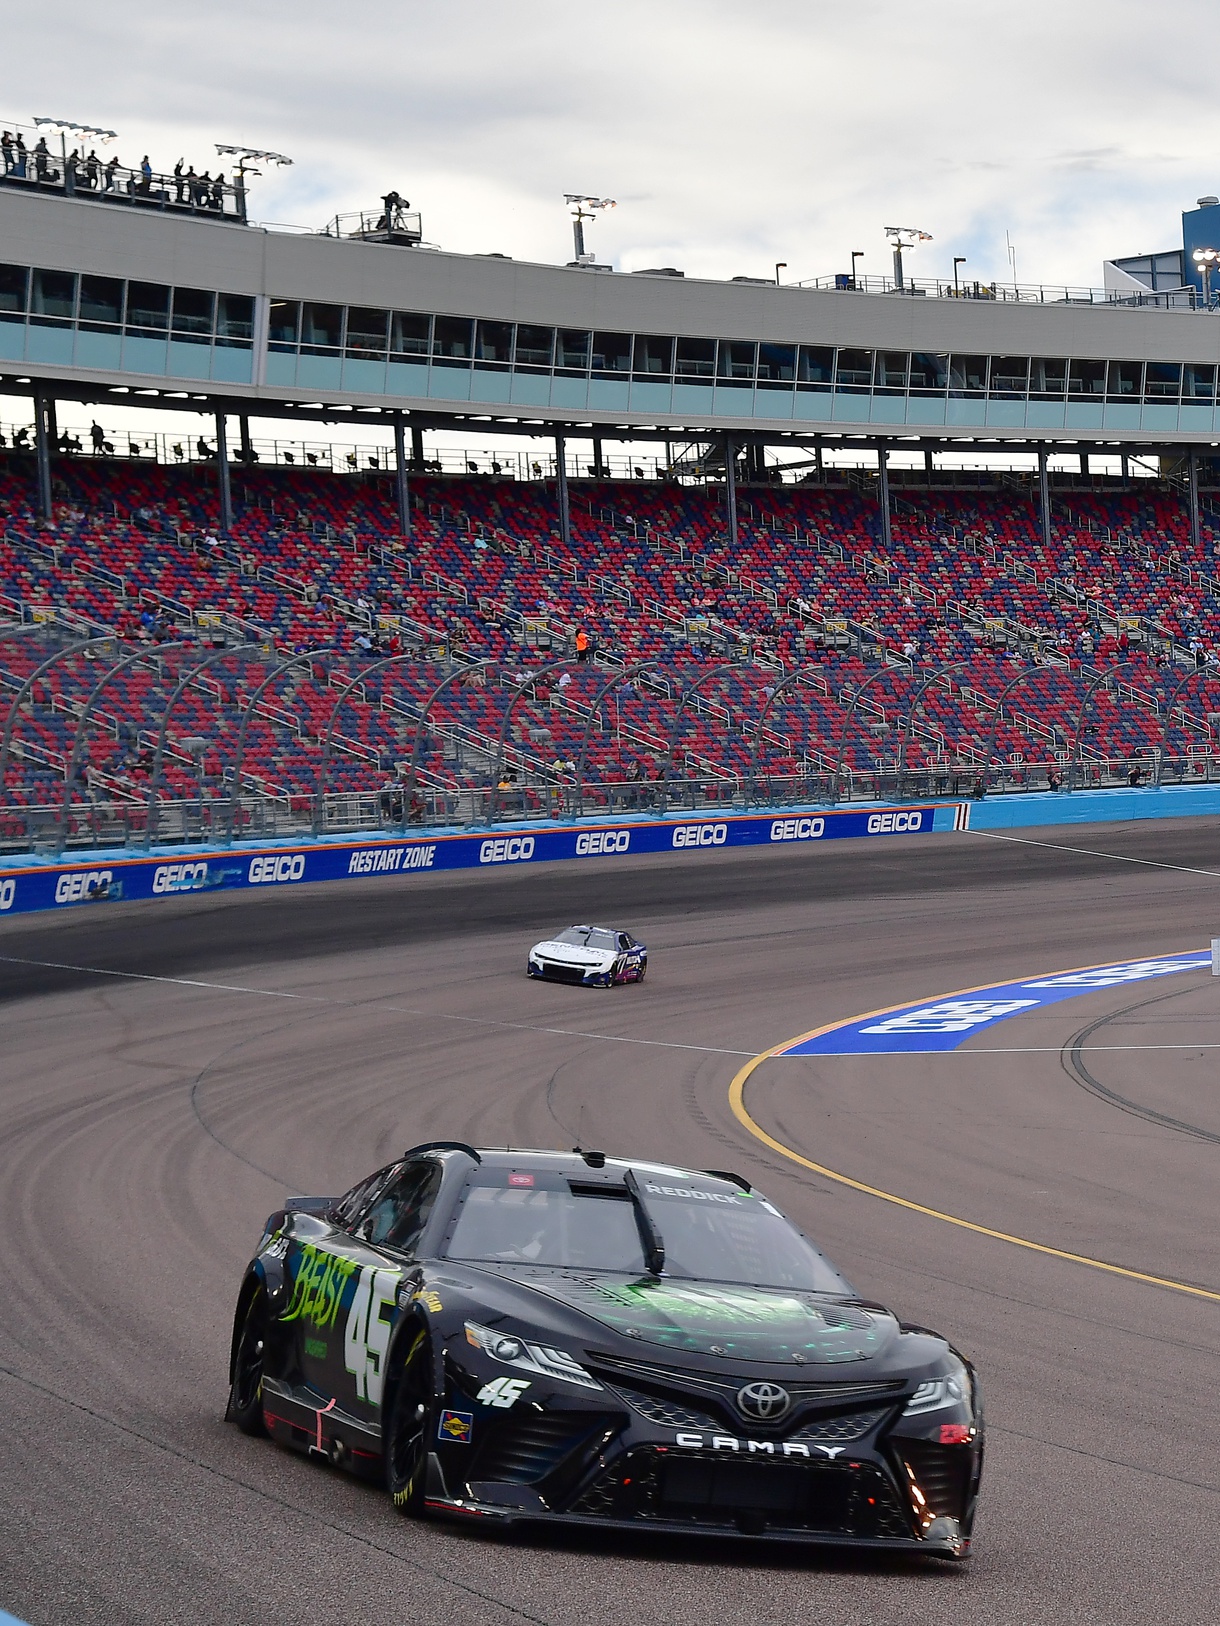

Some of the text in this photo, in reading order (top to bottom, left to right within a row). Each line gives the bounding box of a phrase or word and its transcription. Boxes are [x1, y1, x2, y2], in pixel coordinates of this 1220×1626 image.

[672, 824, 728, 848] GEICO
[770, 817, 825, 840] GEICO
[867, 811, 922, 834] GEICO
[479, 837, 535, 863] GEICO
[576, 830, 630, 855] GEICO
[248, 854, 305, 883] GEICO
[348, 845, 436, 874] RESTART ZONE
[55, 871, 113, 903] GEICO
[152, 862, 207, 894] GEICO
[645, 1184, 743, 1206] REDDICK
[281, 1243, 359, 1330] BEAST
[345, 1265, 403, 1407] 45
[477, 1377, 532, 1409] 45
[675, 1433, 847, 1459] CAMRY
